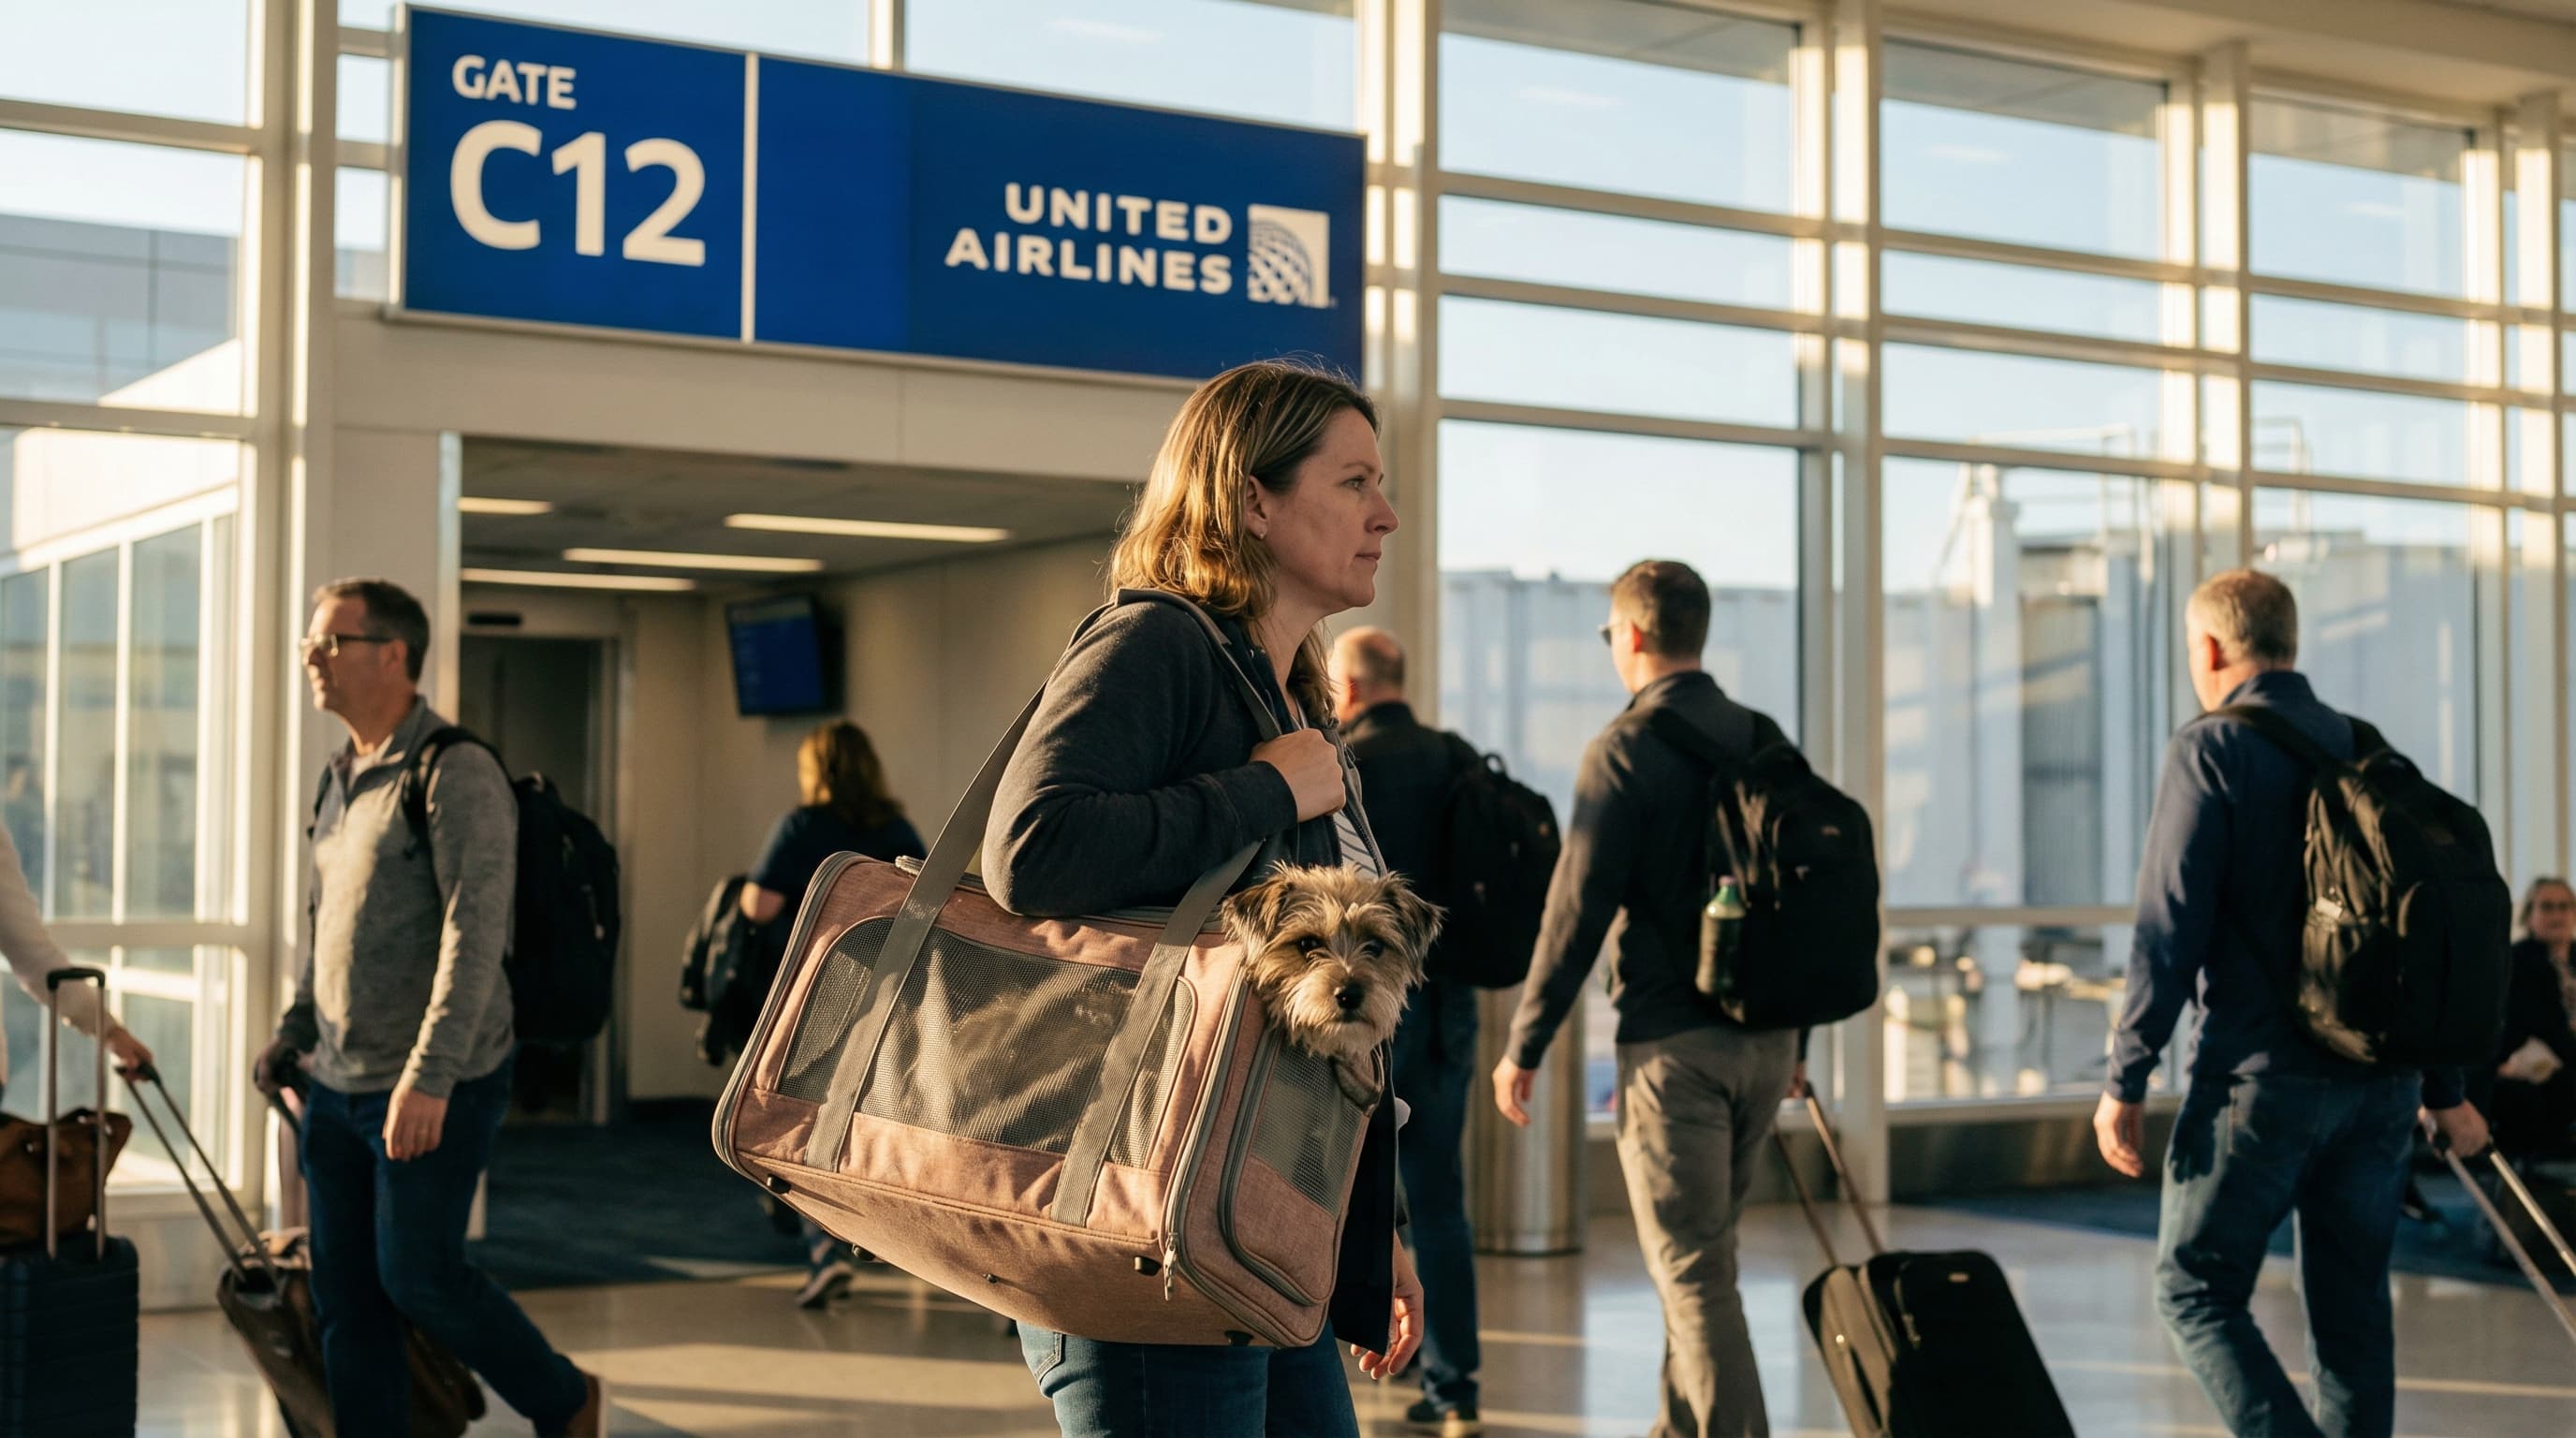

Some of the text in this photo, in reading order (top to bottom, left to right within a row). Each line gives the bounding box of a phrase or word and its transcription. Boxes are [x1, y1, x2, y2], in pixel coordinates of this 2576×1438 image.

[452, 54, 577, 110] GATE
[450, 120, 706, 267] C12
[1005, 183, 1232, 244] UNITED
[945, 228, 1232, 294] AIRLINES
